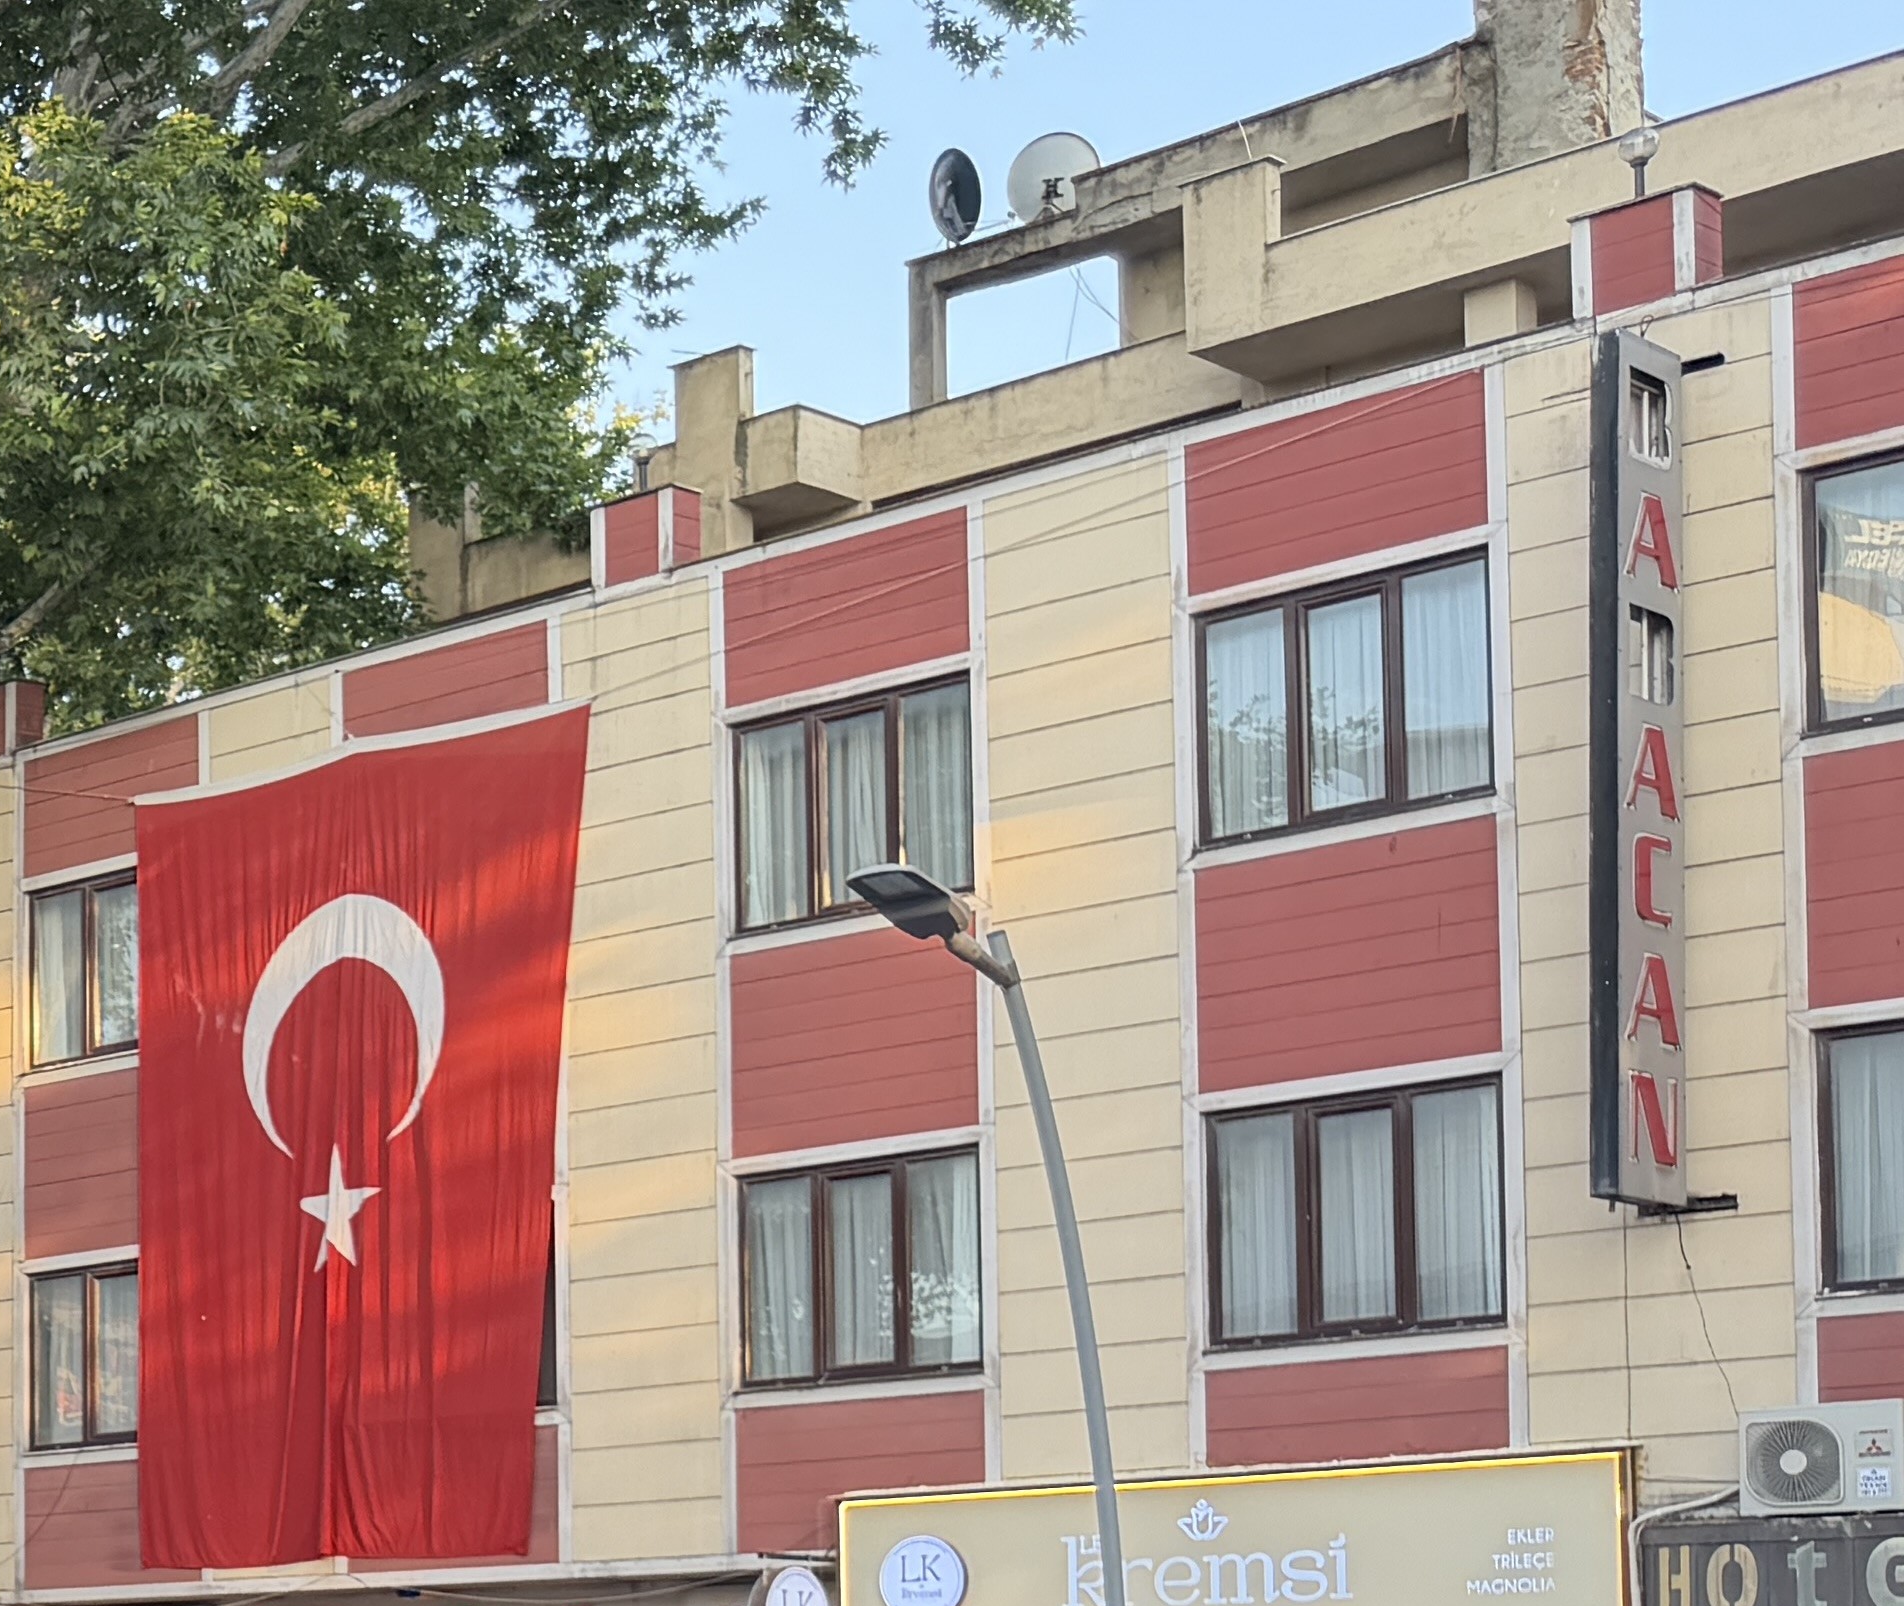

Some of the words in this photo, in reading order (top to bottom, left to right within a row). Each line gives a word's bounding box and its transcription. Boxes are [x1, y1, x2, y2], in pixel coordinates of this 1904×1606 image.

[1623, 366, 1680, 1170] BABACAN
[1507, 1527, 1554, 1545] EKLER
[900, 1554, 941, 1583] LK
[1492, 1551, 1554, 1571] TRİLEÇE
[1466, 1577, 1556, 1595] MAGNOLIA
